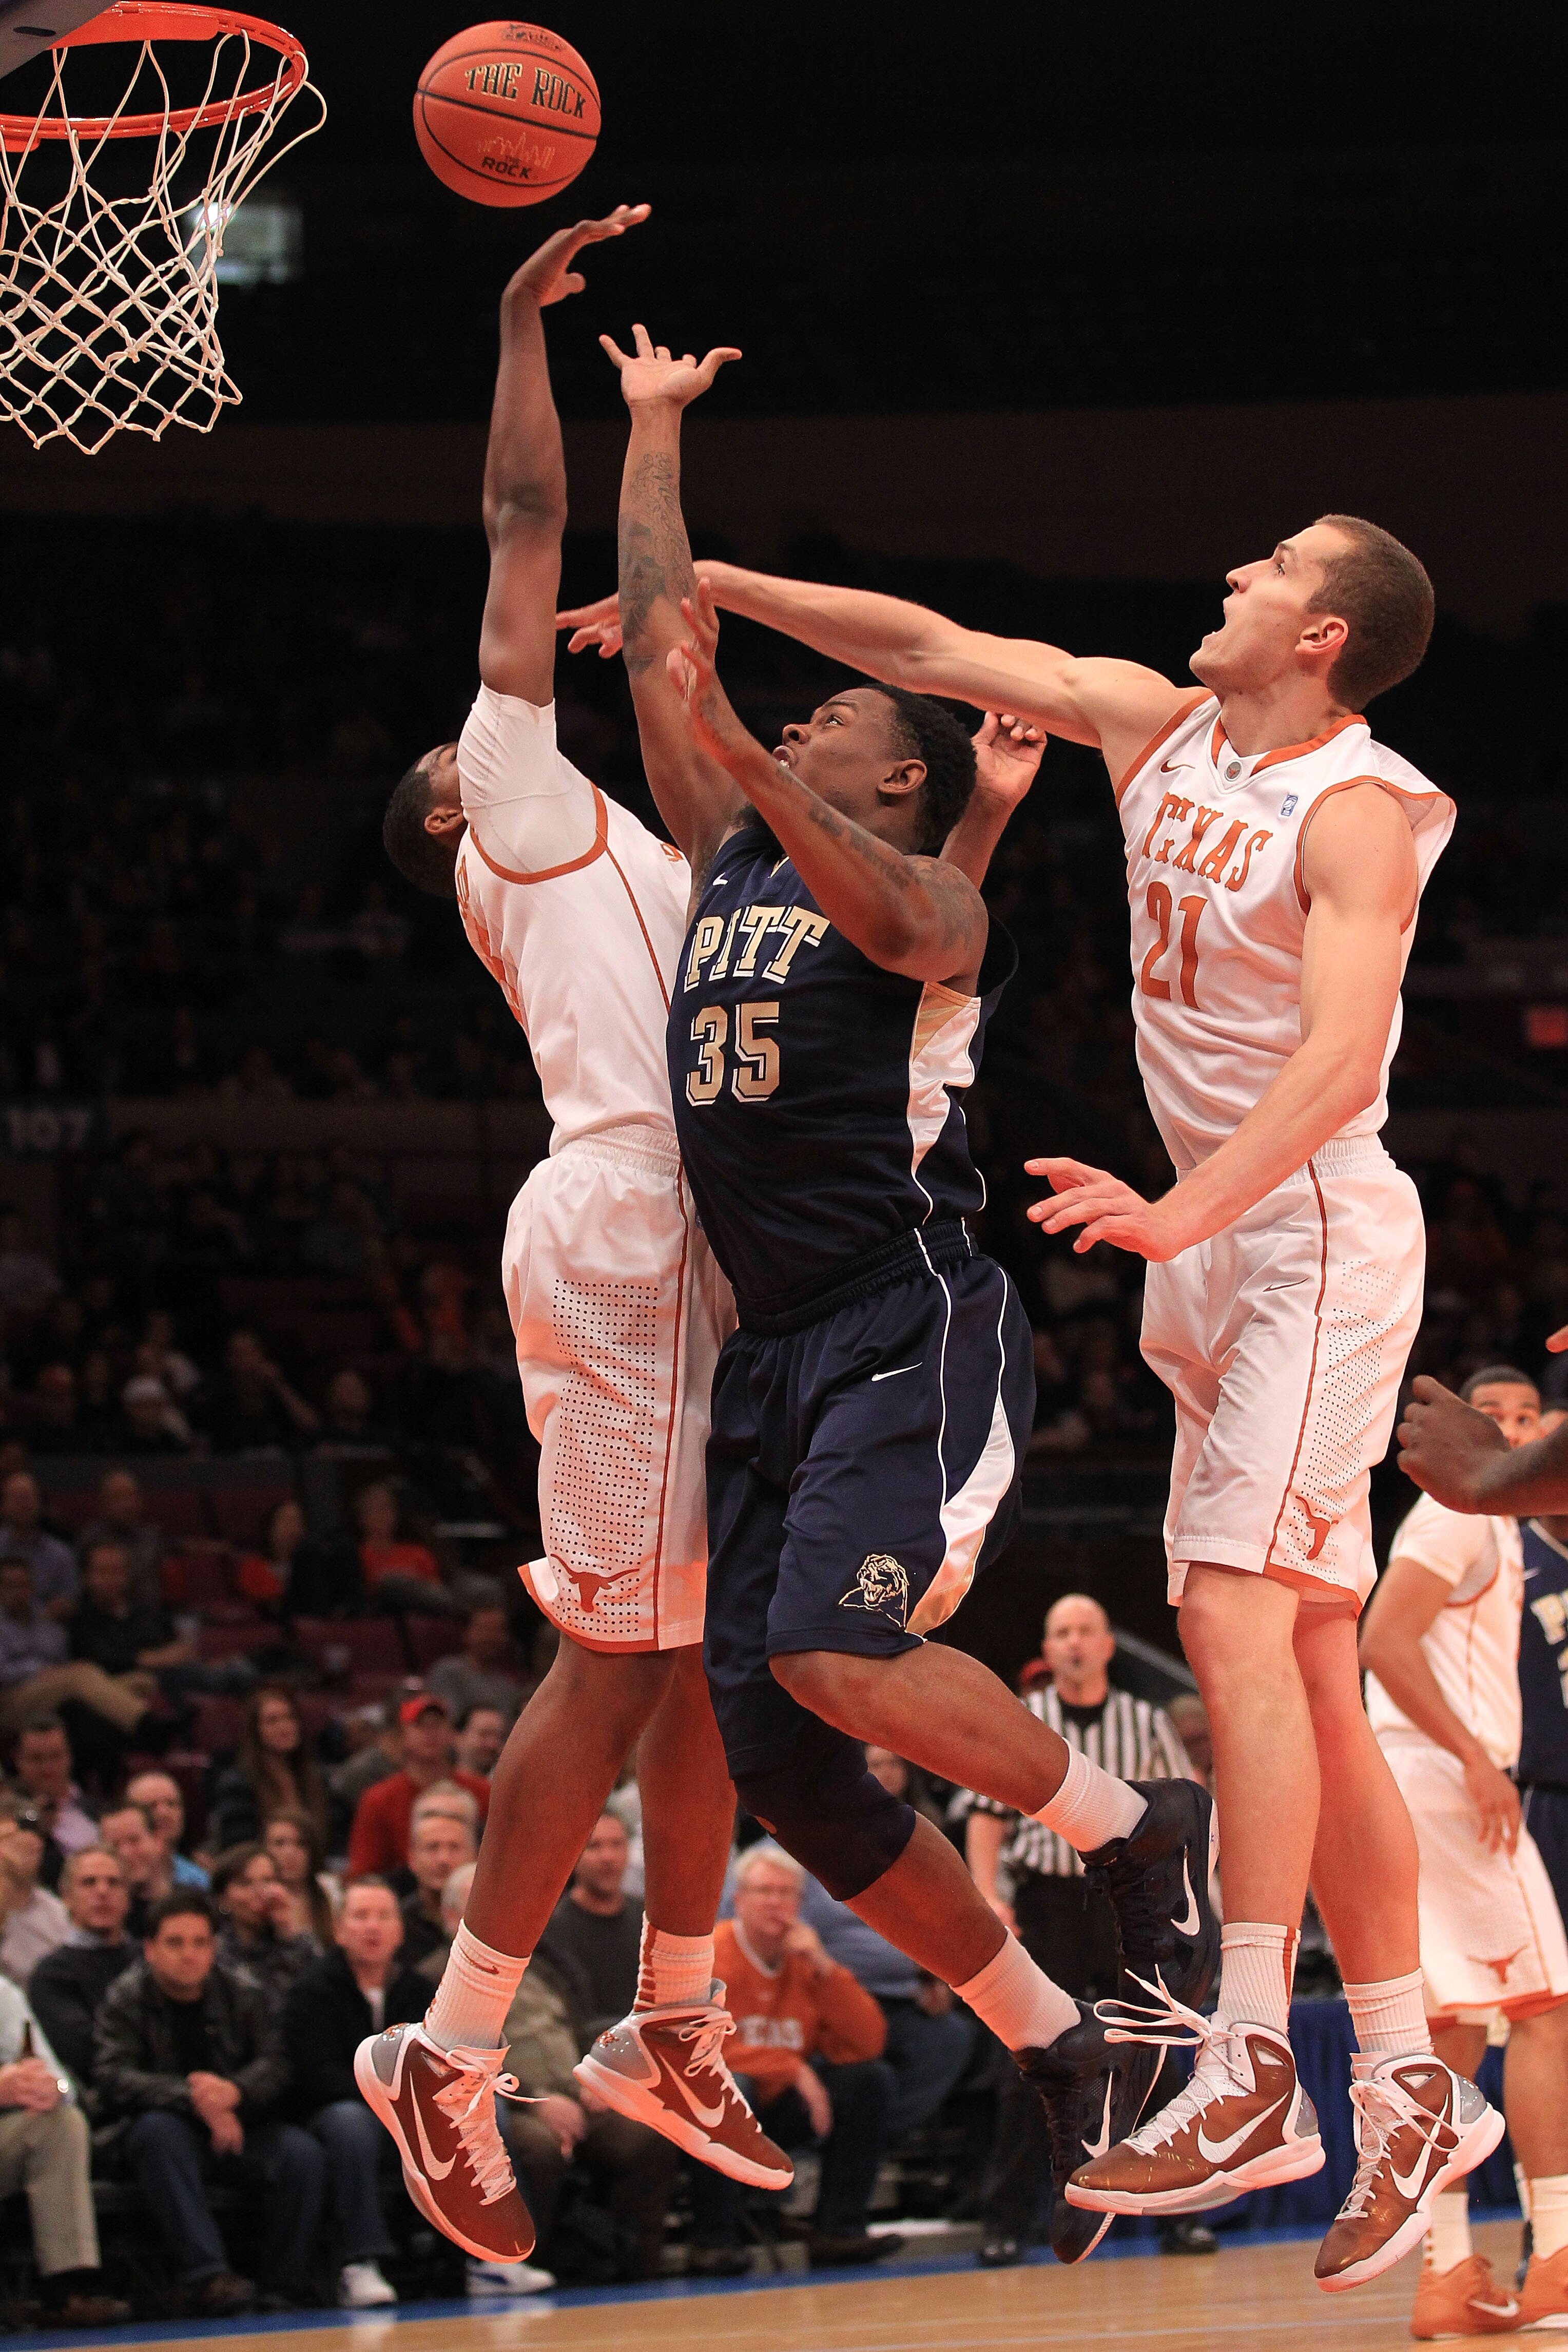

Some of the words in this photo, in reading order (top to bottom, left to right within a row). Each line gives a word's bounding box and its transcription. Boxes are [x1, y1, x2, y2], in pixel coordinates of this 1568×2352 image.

[465, 62, 522, 101] THE
[530, 67, 586, 119] ROCK
[481, 156, 532, 179] ROCK
[684, 905, 830, 993] PITT
[1141, 881, 1208, 1011] 21
[686, 1002, 780, 1107] 35
